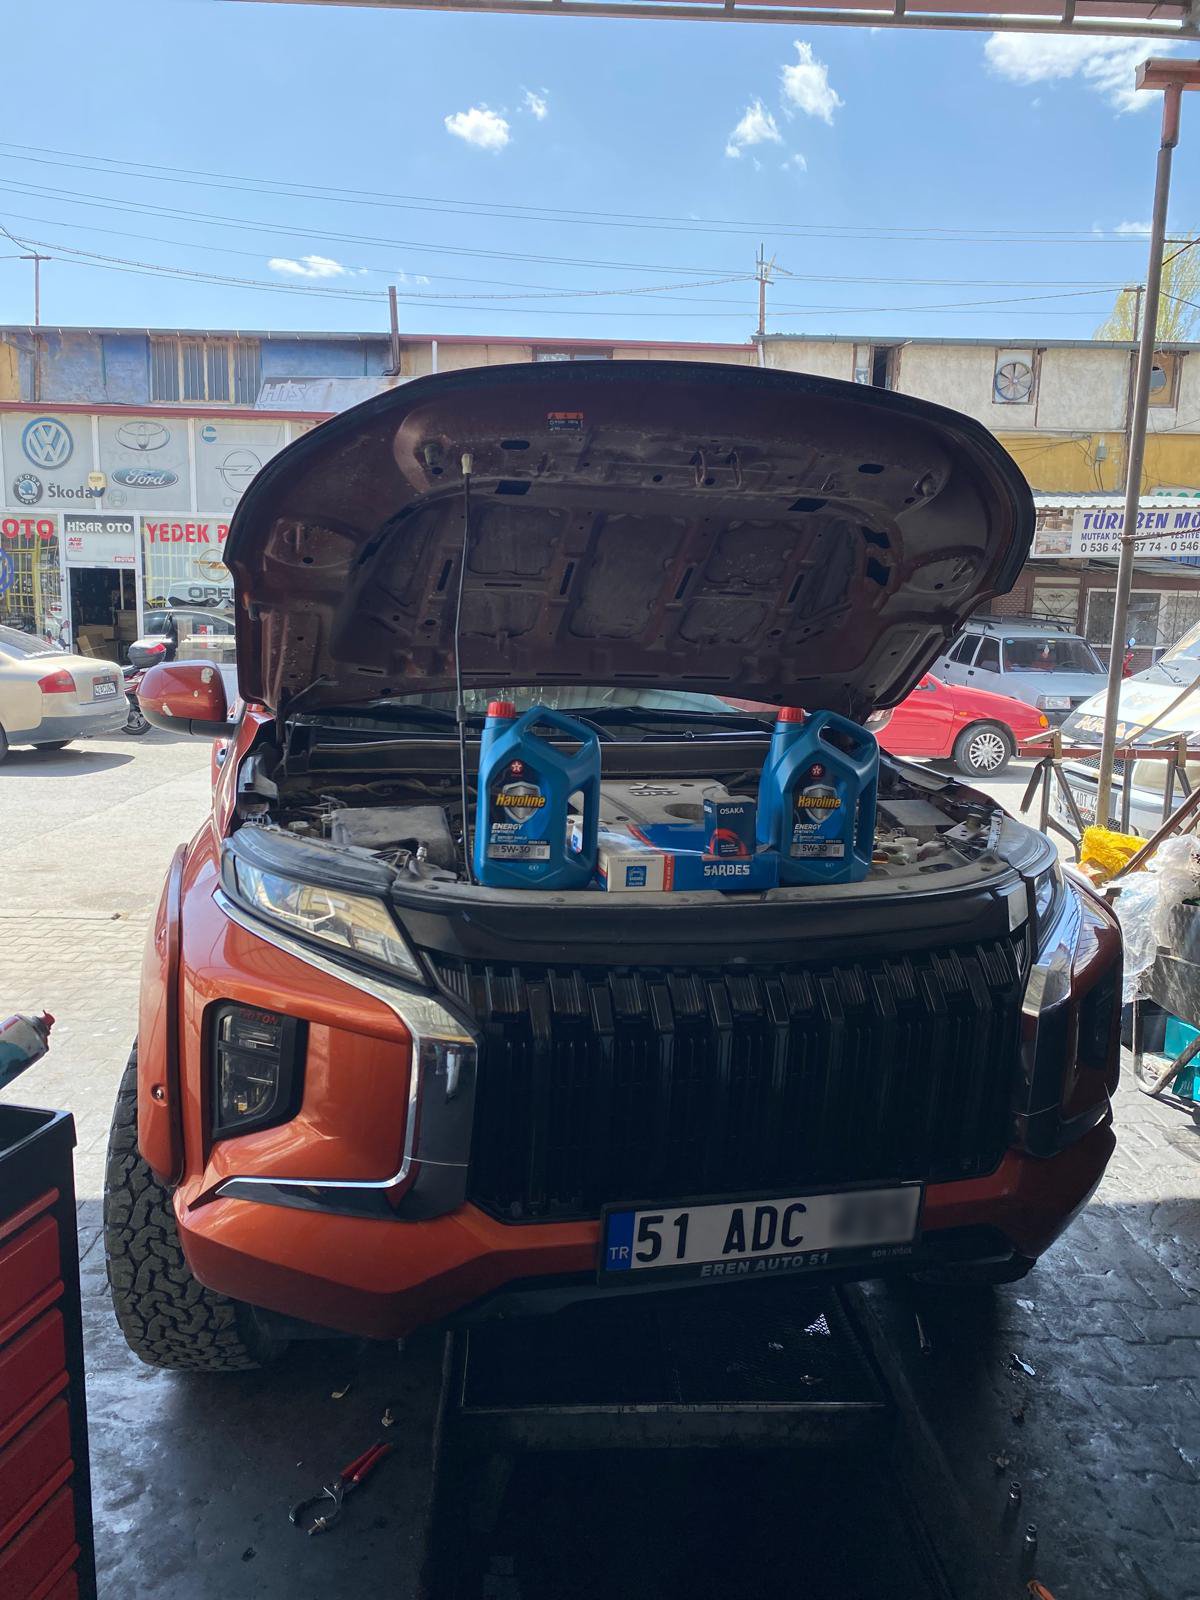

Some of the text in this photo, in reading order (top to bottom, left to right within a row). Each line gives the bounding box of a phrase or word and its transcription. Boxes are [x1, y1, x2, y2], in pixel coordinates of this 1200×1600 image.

[125, 469, 165, 485] Ford
[48, 483, 93, 498] Škoda
[2, 518, 54, 540] OTO
[107, 523, 132, 533] OTO
[146, 523, 209, 544] YEDEK
[1080, 532, 1110, 540] MUTFAK
[1080, 543, 1087, 552] 0
[1090, 542, 1109, 552] 536
[1150, 542, 1161, 551] 74
[1170, 541, 1178, 551] 0
[1179, 541, 1200, 551] 546
[496, 793, 546, 808] Havoline
[798, 795, 842, 809] Havoline
[719, 807, 744, 815] OSAKA
[492, 822, 524, 830] ENERGY
[501, 845, 531, 853] 5W-30
[802, 844, 828, 852] 5W-30
[703, 864, 750, 877] SARDES
[609, 1246, 630, 1260] TR
[635, 1212, 690, 1263] 51
[721, 1202, 807, 1255] ADC
[700, 1252, 830, 1278] EREN AUTO 51
